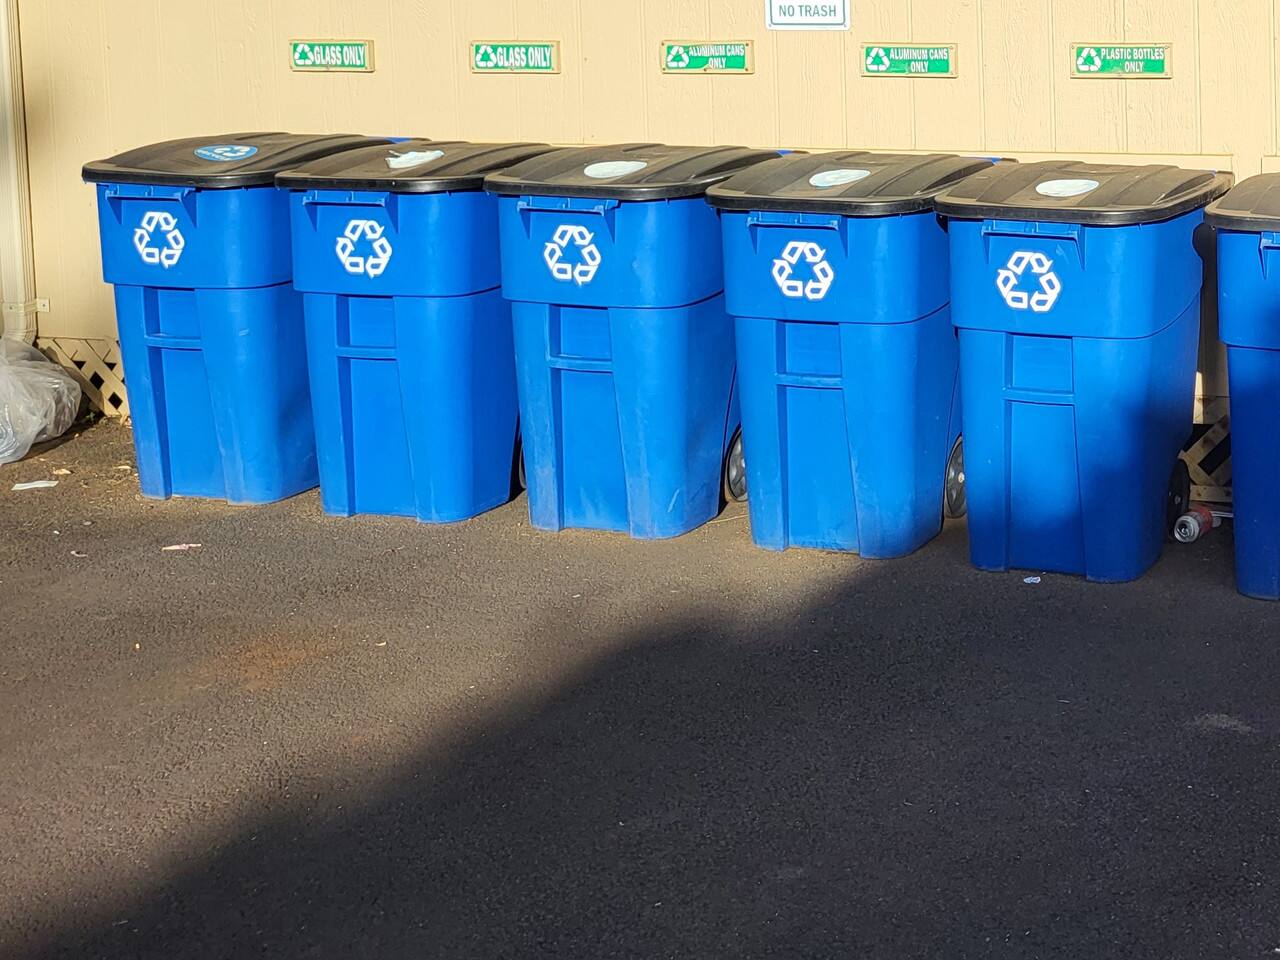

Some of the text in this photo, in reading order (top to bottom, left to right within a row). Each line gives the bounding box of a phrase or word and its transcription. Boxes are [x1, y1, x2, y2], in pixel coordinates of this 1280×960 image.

[778, 5, 837, 17] NO TRASH
[313, 45, 365, 65] GLASS ONLY
[496, 46, 551, 67] GLASS ONLY
[688, 44, 745, 57] ALUMINUM CANS
[889, 48, 948, 60] ALUMINUM CANS
[1100, 47, 1164, 60] PLASTIC BOTTLES
[708, 56, 727, 69] ONLY
[910, 60, 929, 73] ONLY
[1124, 61, 1144, 73] ONLY
